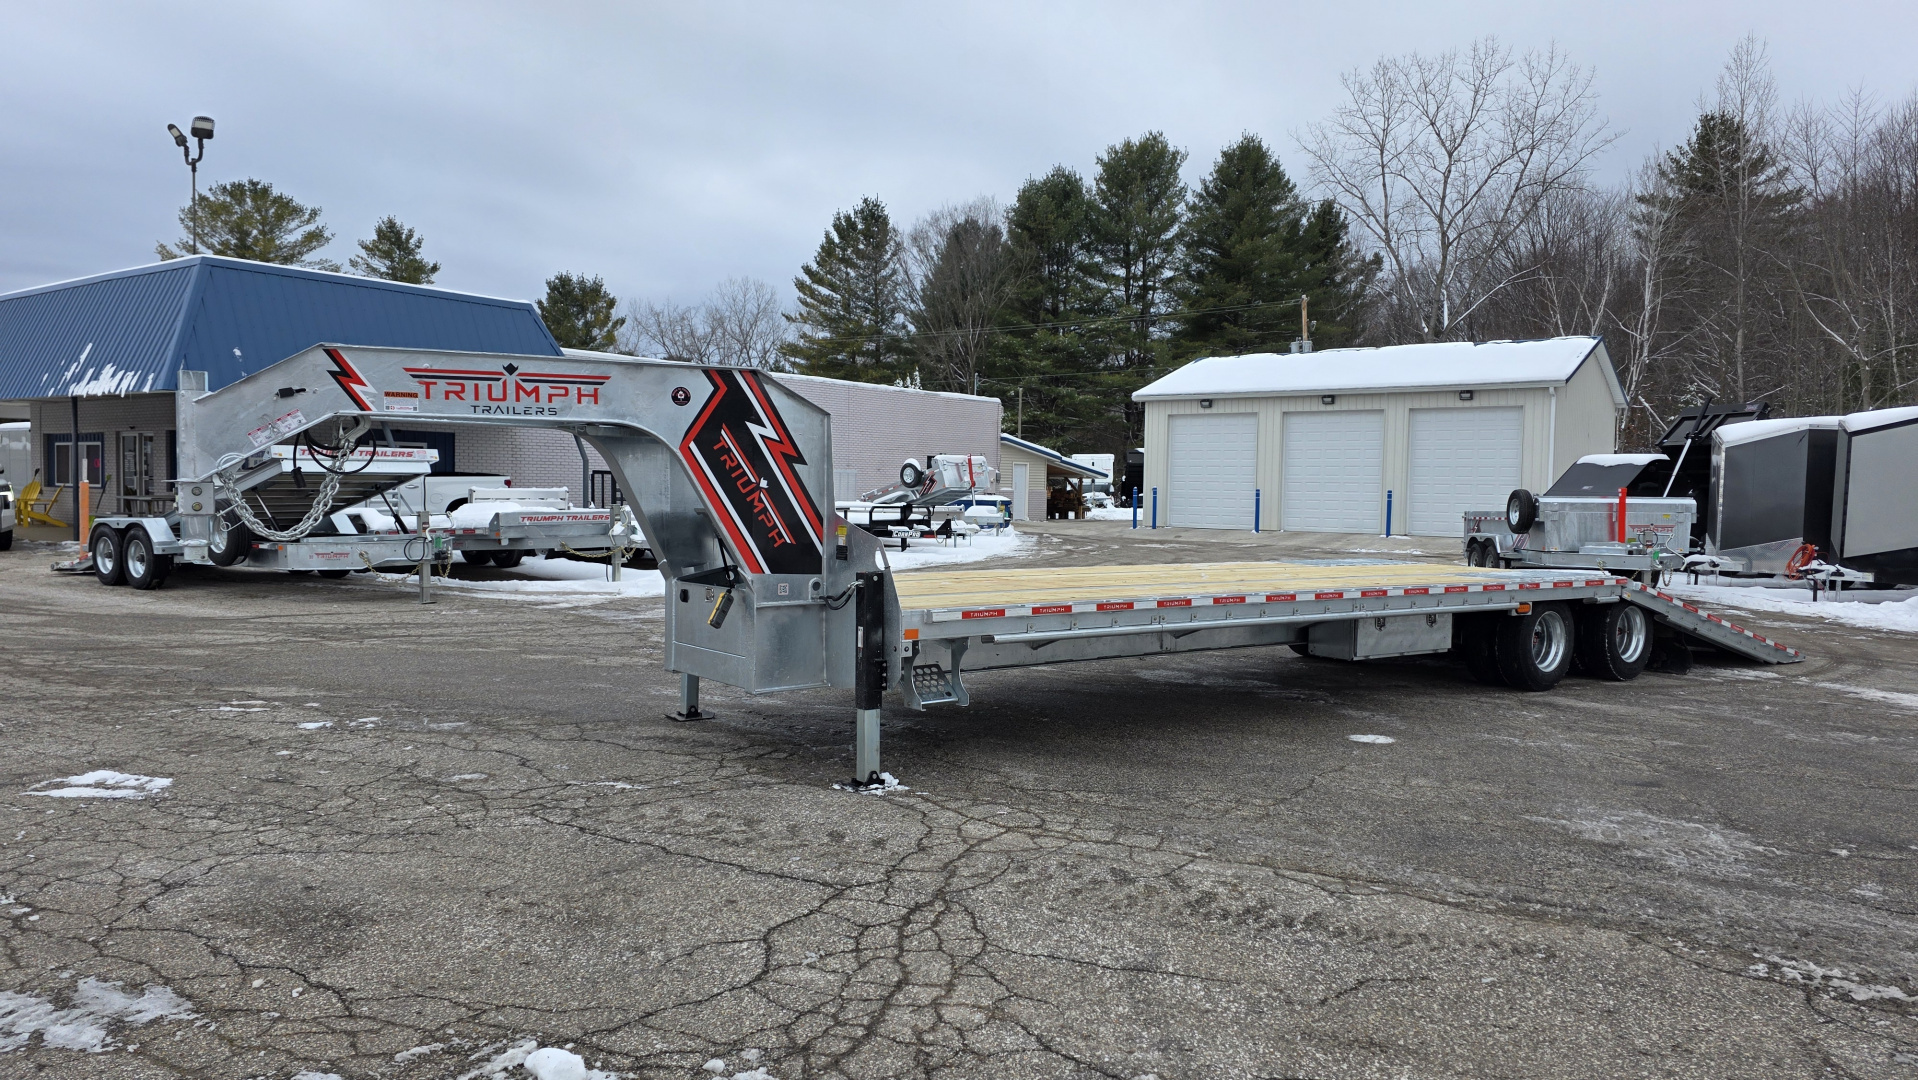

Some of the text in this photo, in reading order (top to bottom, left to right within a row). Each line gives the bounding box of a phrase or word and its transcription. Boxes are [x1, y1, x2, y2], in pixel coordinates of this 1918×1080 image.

[417, 379, 600, 405] TRIUMPH
[471, 405, 558, 416] TRAILERS
[358, 450, 413, 458] TRAILERS
[713, 436, 785, 548] TRIUMPH
